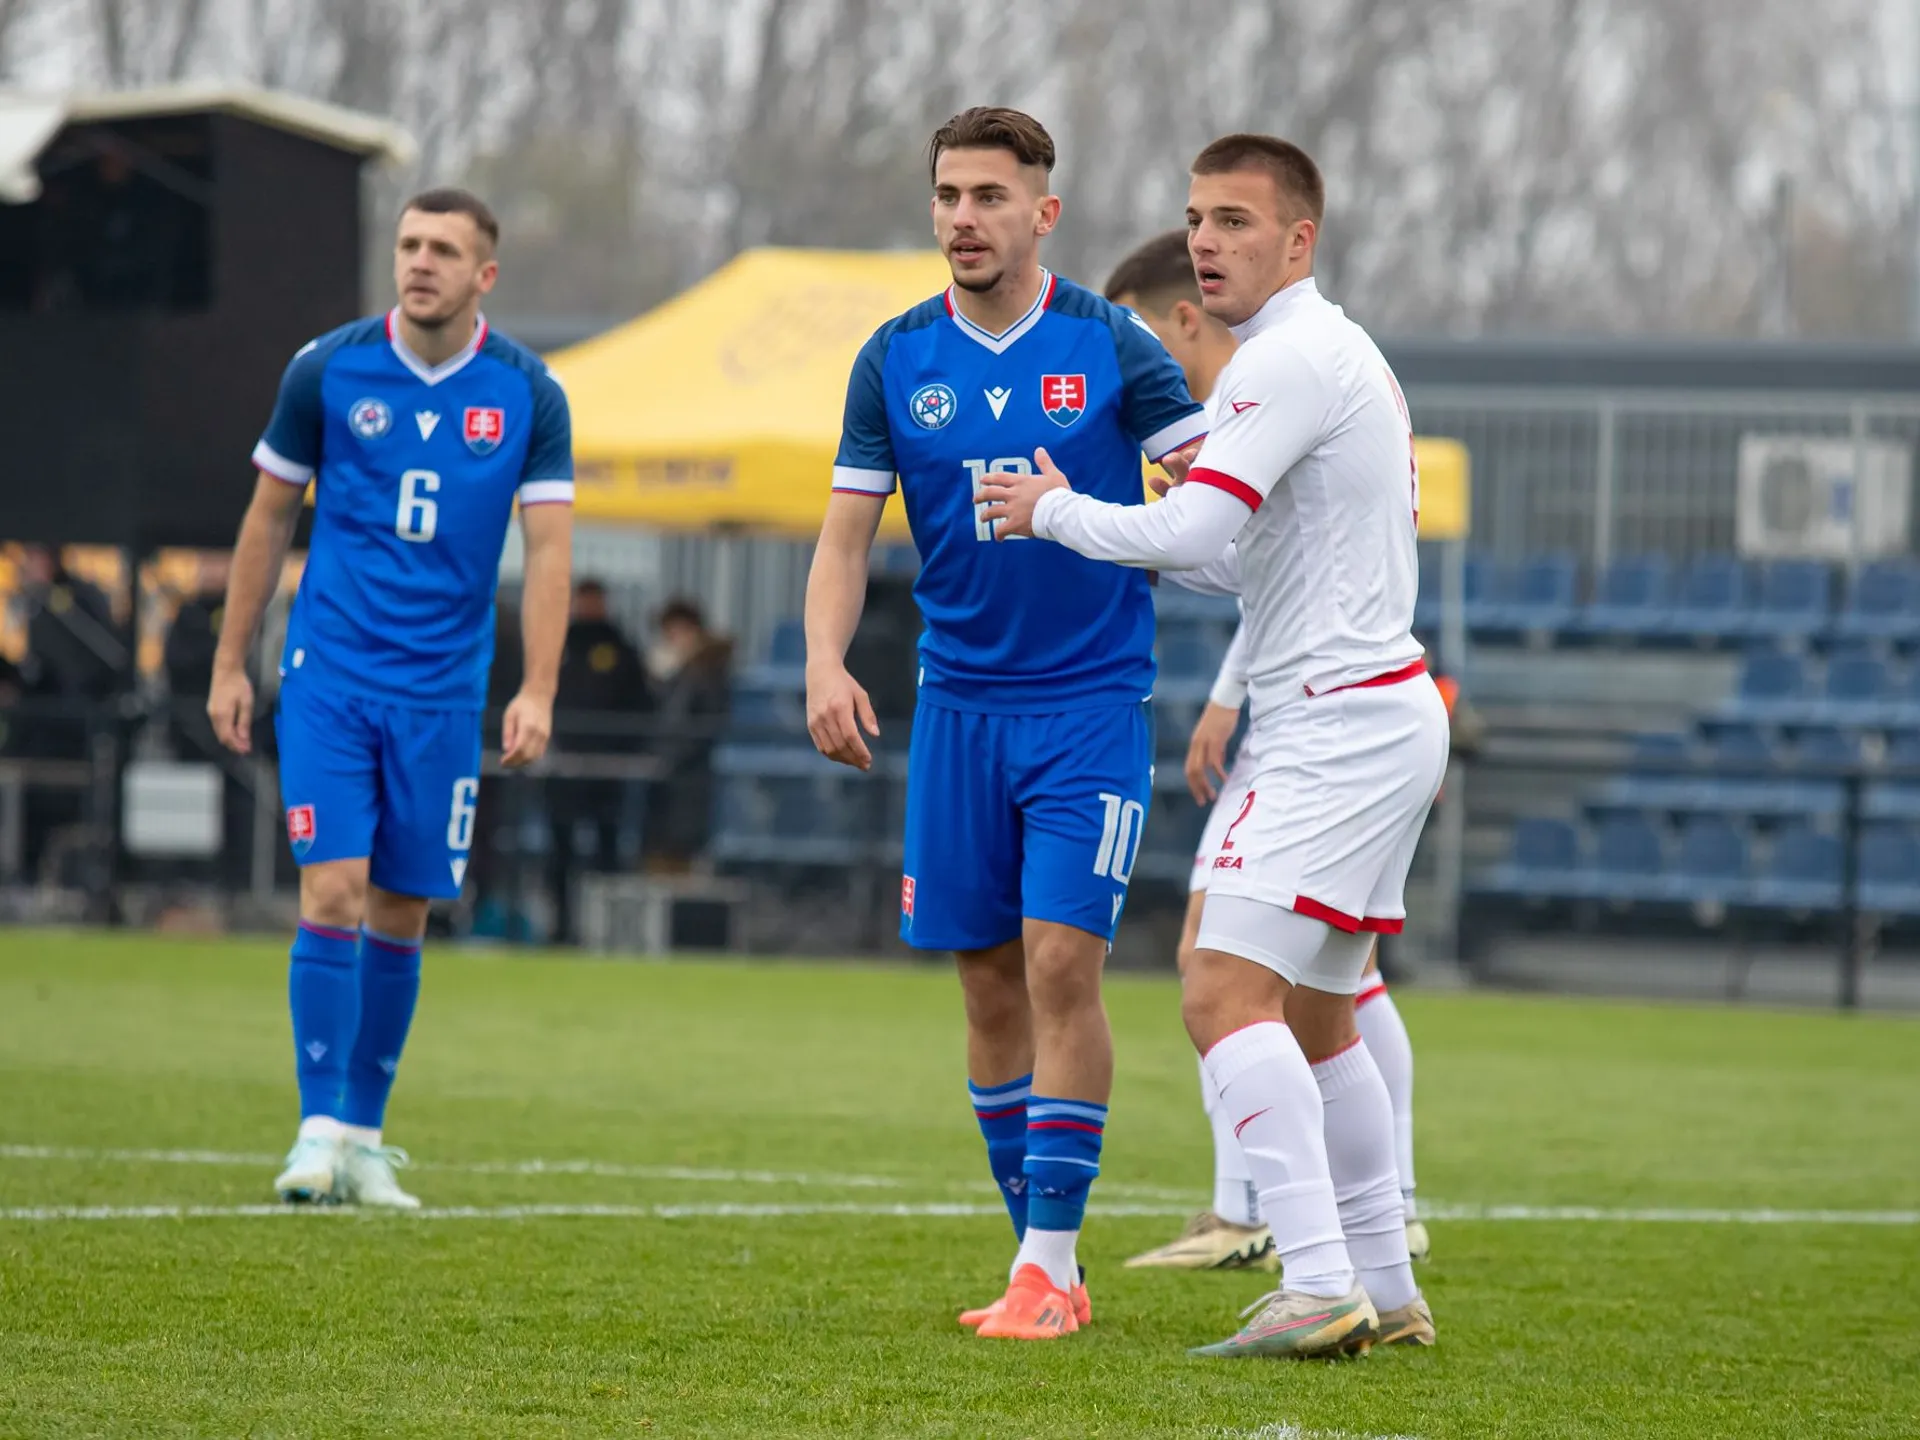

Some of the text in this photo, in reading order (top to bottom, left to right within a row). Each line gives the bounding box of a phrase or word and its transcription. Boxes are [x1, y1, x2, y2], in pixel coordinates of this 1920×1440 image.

[396, 469, 441, 543] 6
[447, 777, 479, 851] 6
[1093, 792, 1144, 886] 10
[1221, 790, 1256, 851] 2
[1212, 856, 1243, 870] GEA
